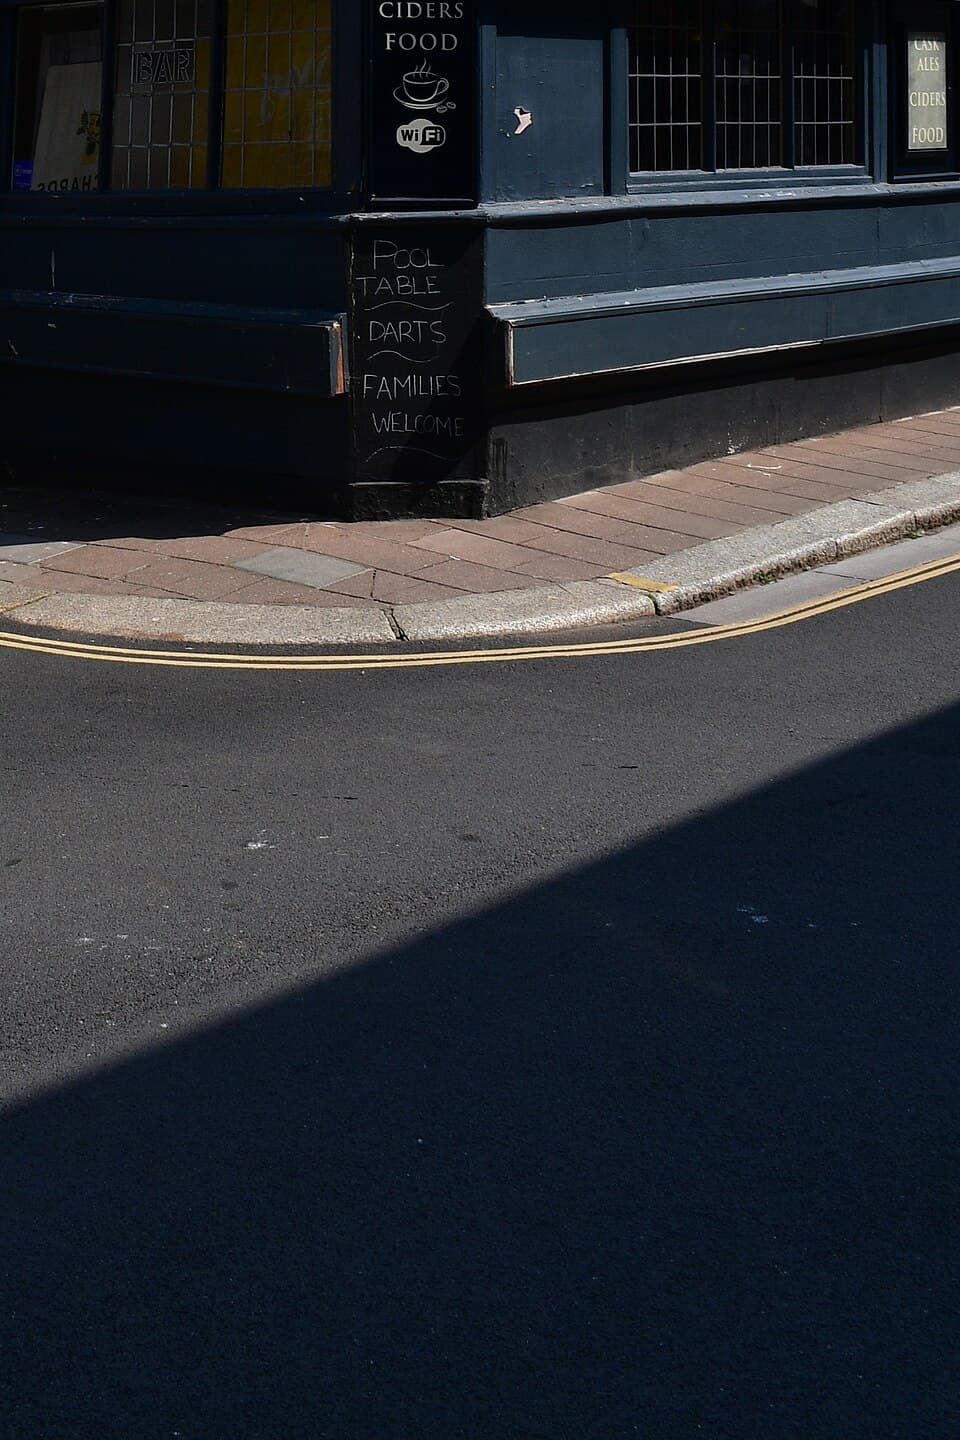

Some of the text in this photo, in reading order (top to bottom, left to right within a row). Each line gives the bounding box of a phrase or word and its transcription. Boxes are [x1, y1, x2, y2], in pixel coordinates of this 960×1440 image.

[379, 1, 464, 19] CIDERS
[385, 32, 458, 51] FOOD
[914, 38, 940, 51] CASK
[135, 49, 192, 83] BAR
[917, 57, 940, 72] ALES
[909, 91, 947, 107] CIDERS
[912, 127, 944, 144] FOOD
[373, 240, 446, 271] POOL
[356, 275, 441, 297] TABLE
[369, 320, 447, 344] DARTS
[363, 374, 463, 401] FAMILIES
[372, 411, 465, 438] WELCOME
